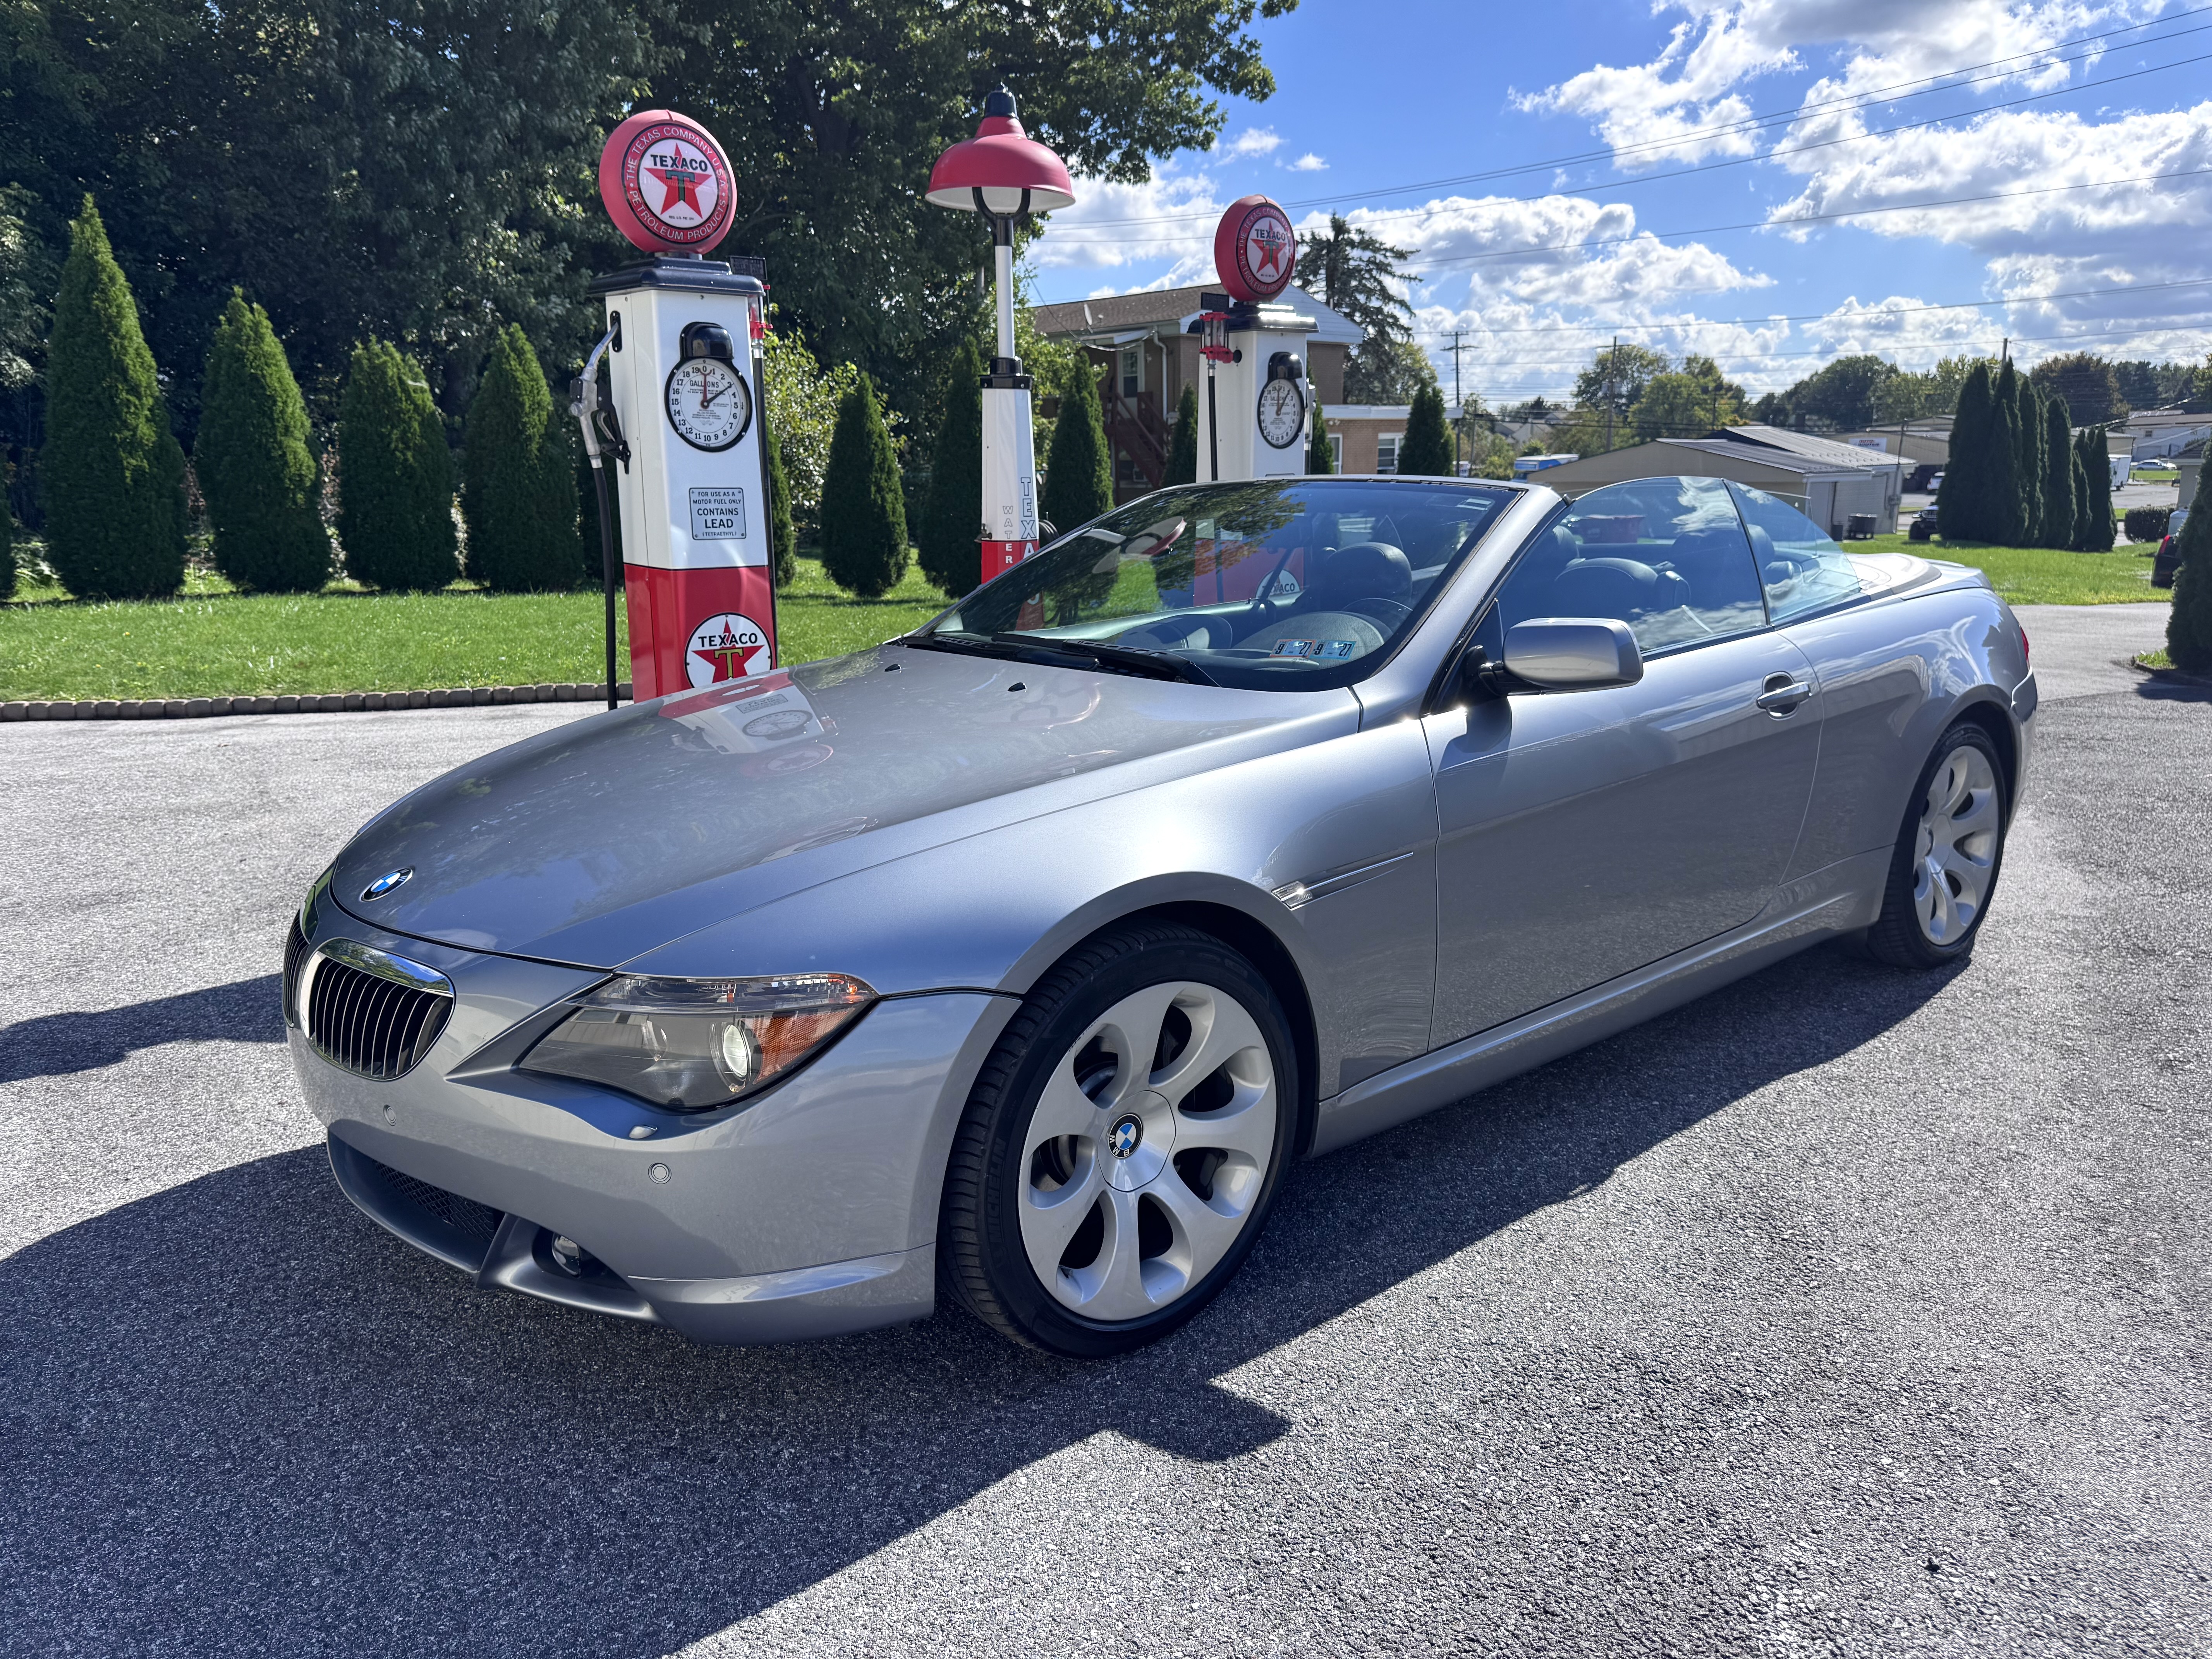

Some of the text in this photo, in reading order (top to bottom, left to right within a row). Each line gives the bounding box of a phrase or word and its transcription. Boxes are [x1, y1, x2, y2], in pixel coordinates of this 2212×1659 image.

[627, 157, 637, 181] THE
[632, 129, 661, 154] TEXAS
[663, 127, 713, 155] COMPANY
[651, 154, 708, 172] TEXACO
[665, 169, 696, 203] T
[629, 191, 726, 240] PETROLEUM PRODUCTS
[1245, 212, 1261, 228] TEXAS
[1255, 228, 1286, 241] TEXACO
[690, 380, 720, 388] GALLONS
[697, 508, 739, 516] CONTAINS
[705, 519, 733, 529] LEAD
[1002, 505, 1013, 564] WATER
[698, 633, 758, 647] TEXACO
[1299, 641, 1312, 656] 27
[1338, 643, 1352, 657] 27
[1109, 1135, 1130, 1156] BMW
[988, 1137, 1007, 1243] MICHELIN
